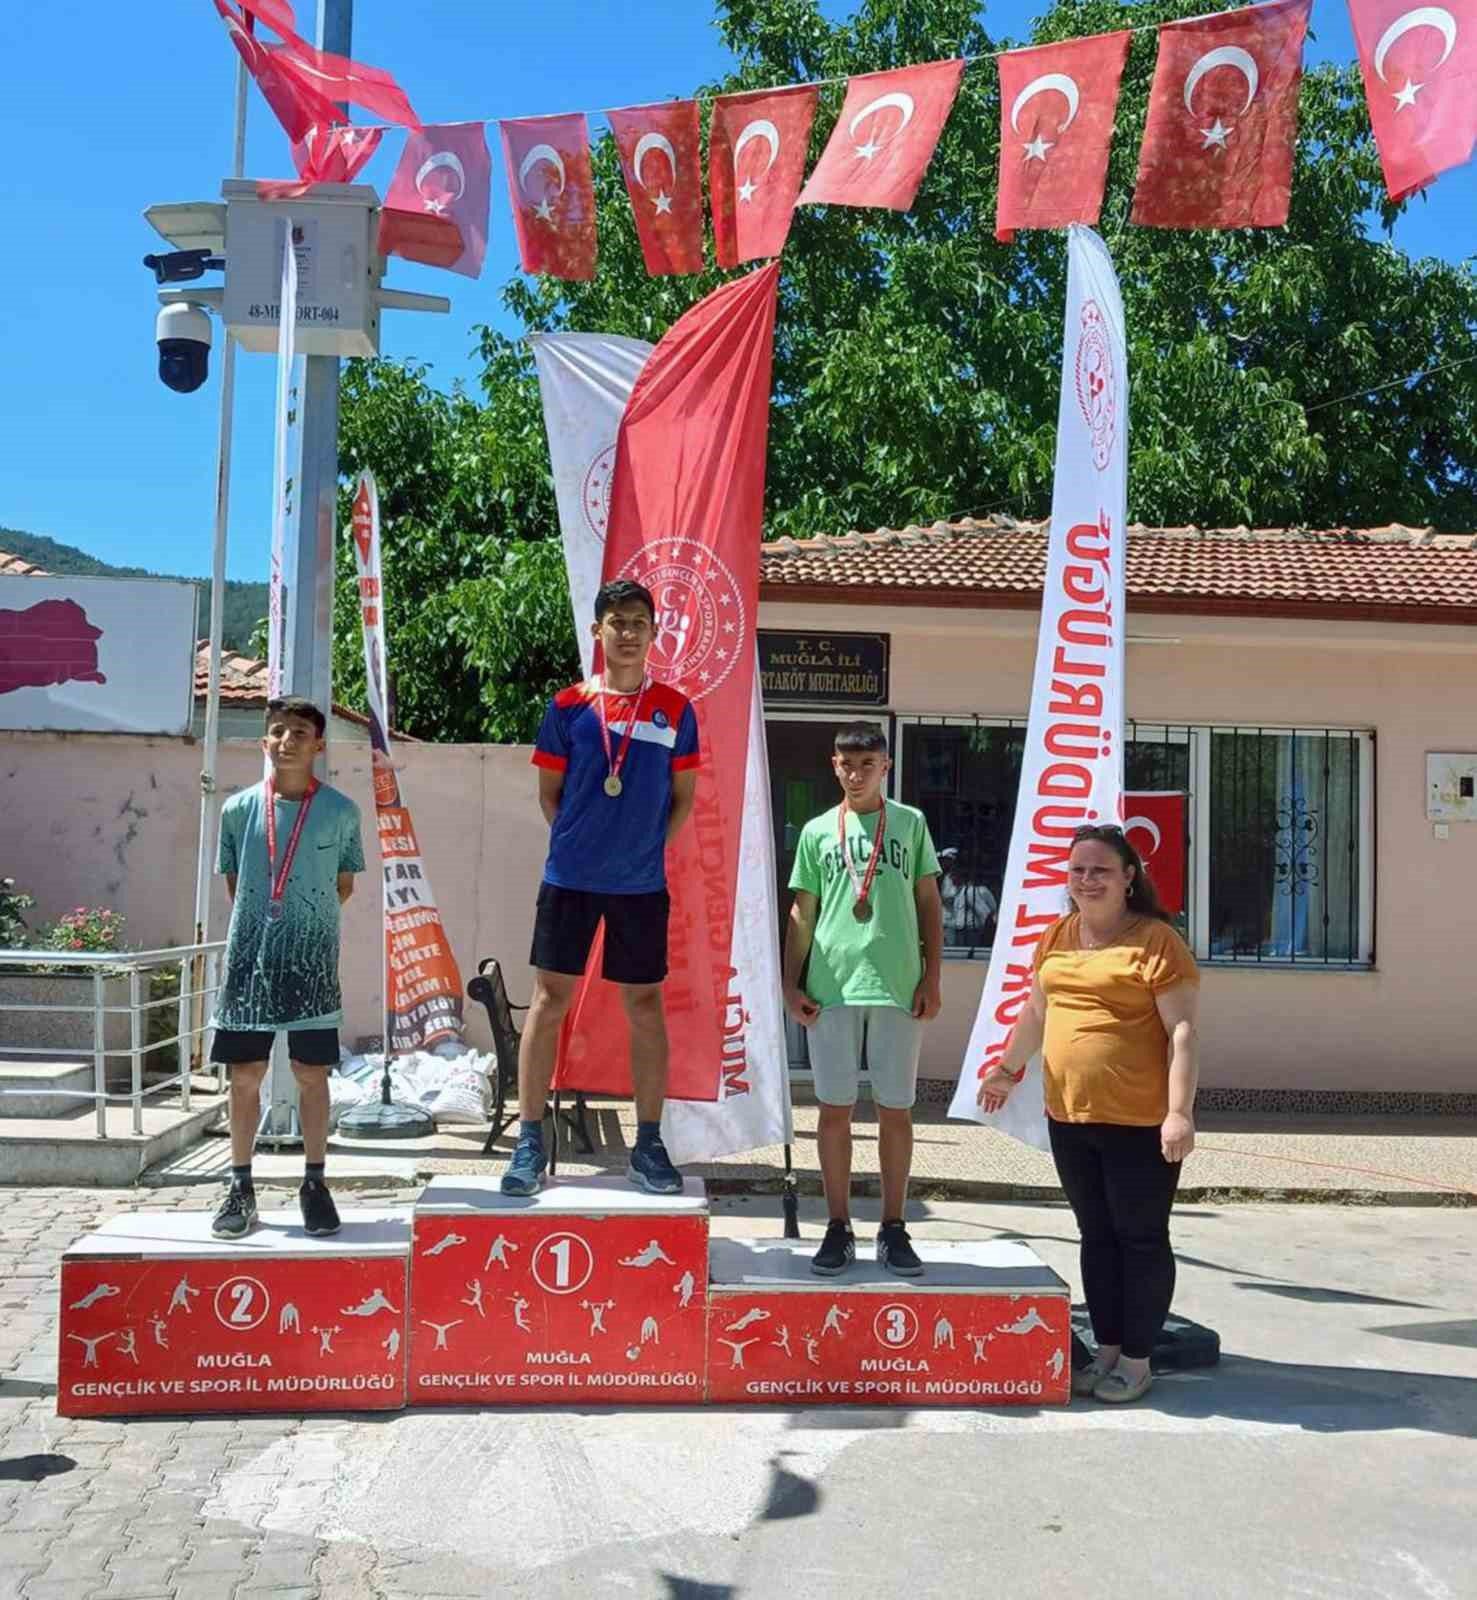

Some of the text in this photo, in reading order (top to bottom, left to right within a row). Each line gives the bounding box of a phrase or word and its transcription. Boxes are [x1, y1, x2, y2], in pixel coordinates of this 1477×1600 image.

[818, 641, 836, 651] C.
[770, 650, 861, 666] MUĞLA İLİ
[761, 667, 878, 693] RTAKÖY MUHTARLIĞI
[550, 1239, 571, 1287] 1
[230, 1283, 254, 1323] 2
[886, 1309, 906, 1343] 3
[197, 1352, 272, 1368] MUĞLA
[526, 1350, 592, 1364] MUĞLA
[860, 1357, 929, 1372] MUĞLA
[71, 1374, 395, 1398] GENÇLİK VE SPOR İL MÜDÜRLÜĞÜ
[419, 1372, 697, 1389] GENÇLİK VE SPOR İL MÜDÜRLÜĞÜ
[746, 1379, 1043, 1396] GENÇLİK VE SPOR İL MÜDÜRLÜĞÜ
